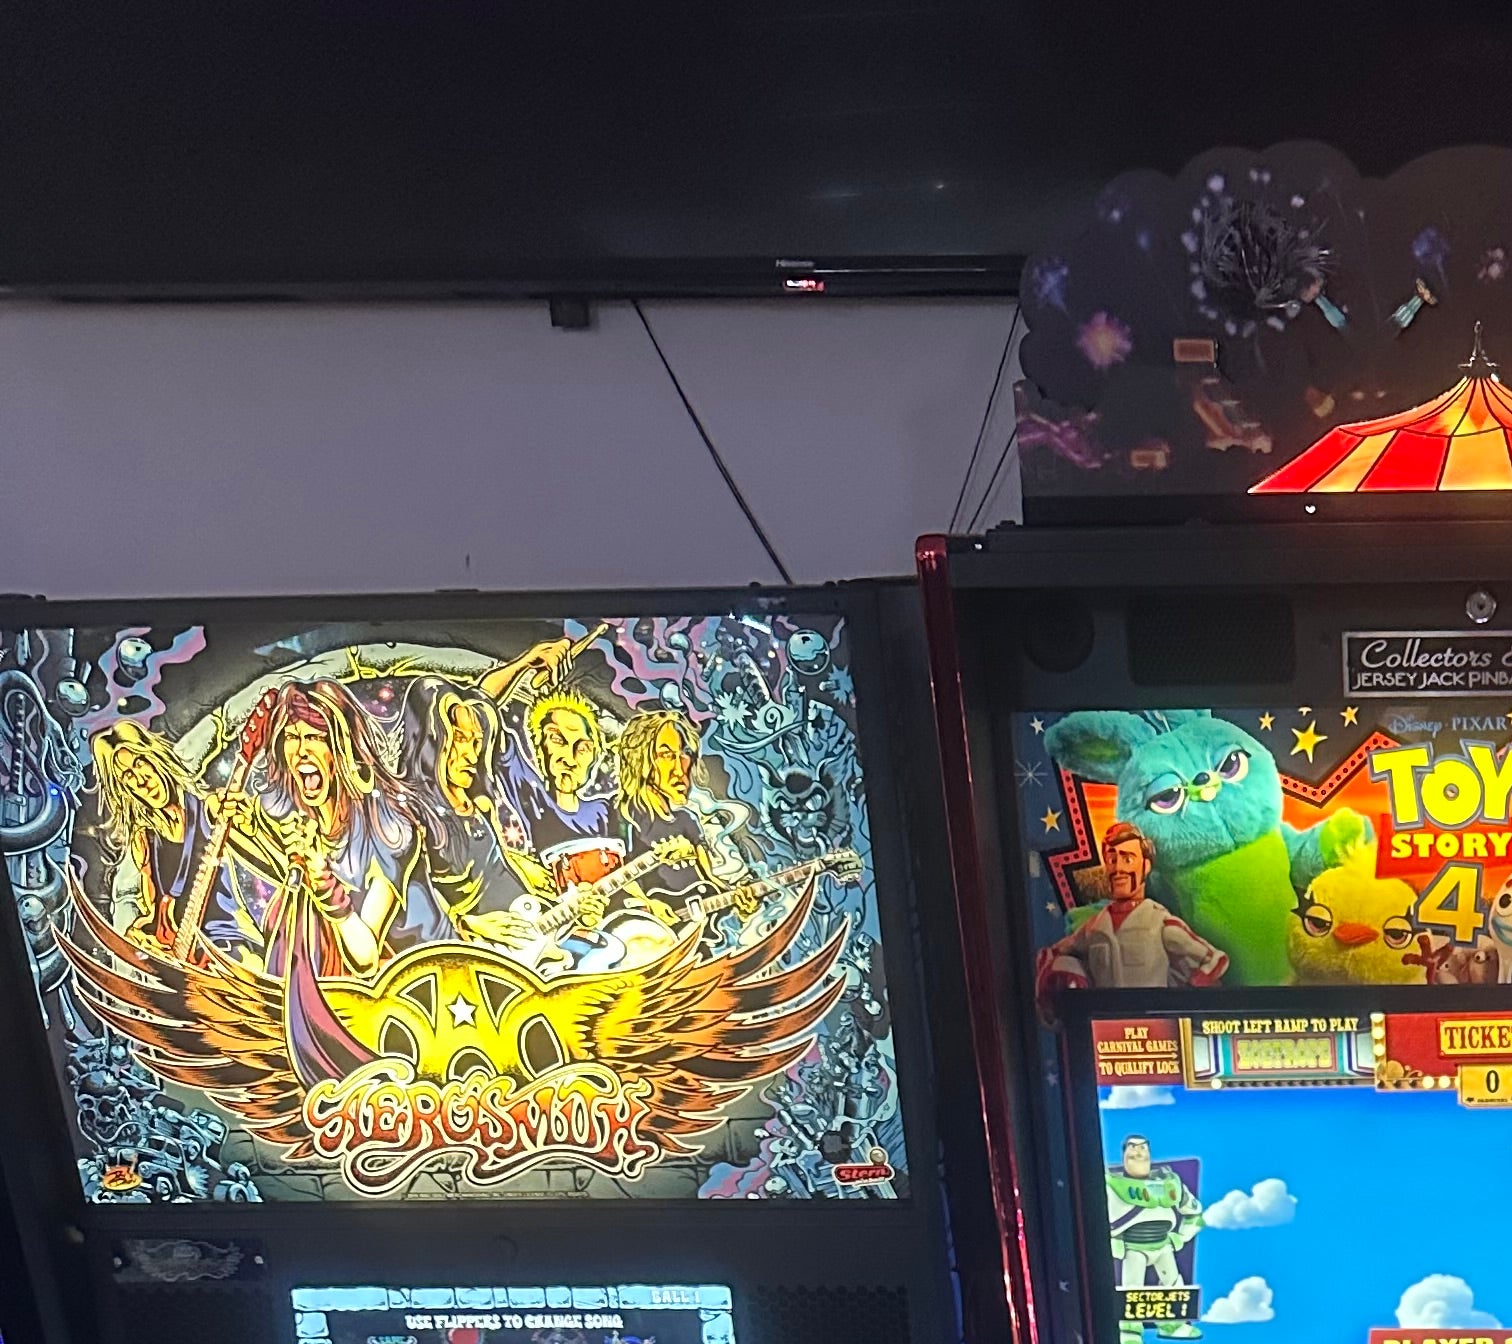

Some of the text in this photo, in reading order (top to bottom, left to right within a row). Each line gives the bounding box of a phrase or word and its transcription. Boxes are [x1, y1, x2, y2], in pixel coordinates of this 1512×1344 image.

[1360, 638, 1493, 669] Collectors
[1351, 670, 1416, 691] JERSEY
[1417, 671, 1466, 690] JACK
[1388, 714, 1509, 738] Disney PIXAR
[1390, 832, 1512, 858] STORY
[1411, 859, 1491, 949] 4
[1123, 1026, 1149, 1040] PLAY
[1202, 1017, 1359, 1035] SHOOT LEFT RAMP TO PLAY
[1097, 1039, 1178, 1054] CARNIVAL GAMES
[1099, 1061, 1180, 1076] TO QUALIFY LOCK
[1485, 1069, 1499, 1094] 0
[839, 1168, 888, 1181] Stern
[651, 1290, 691, 1305] BALL
[1124, 1302, 1176, 1319] LEVEL
[405, 1314, 624, 1330] USE FLIPPERS TO CHANGE SONG
